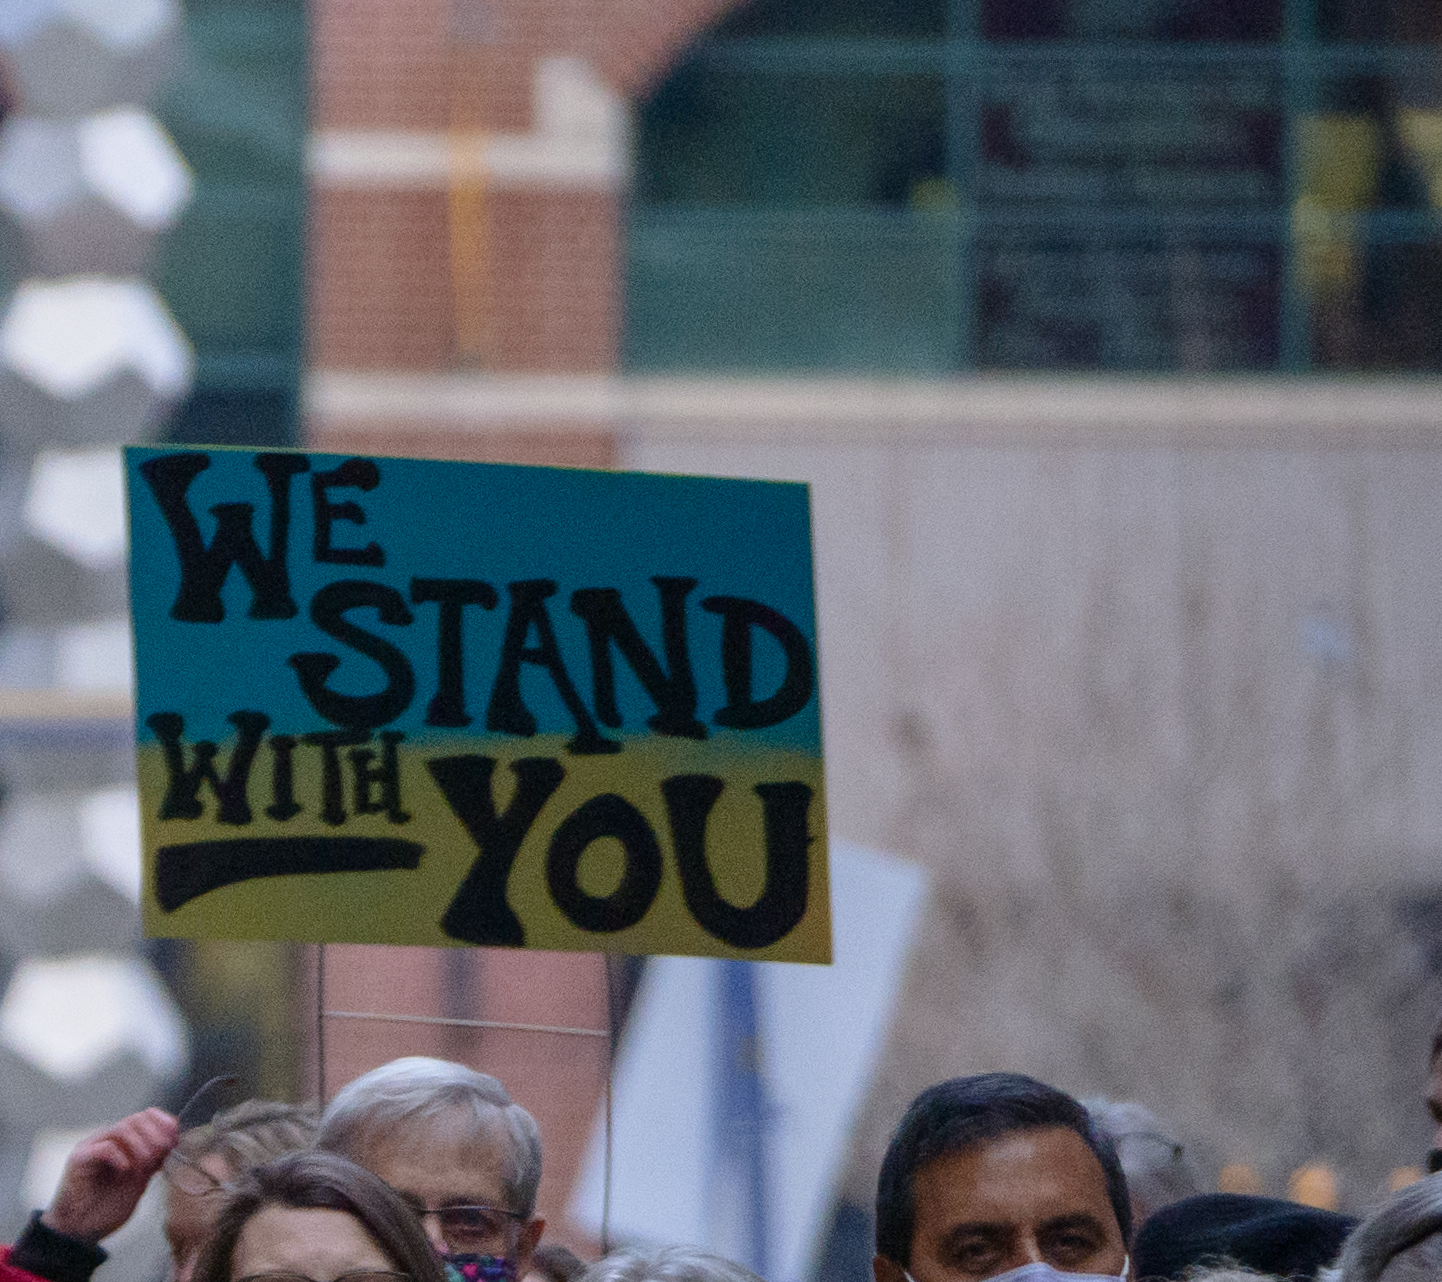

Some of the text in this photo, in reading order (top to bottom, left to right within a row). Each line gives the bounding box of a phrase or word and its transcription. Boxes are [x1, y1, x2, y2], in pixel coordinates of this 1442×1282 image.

[139, 453, 386, 623] WE
[288, 576, 814, 755] STAND
[147, 711, 815, 949] WITH YOU
